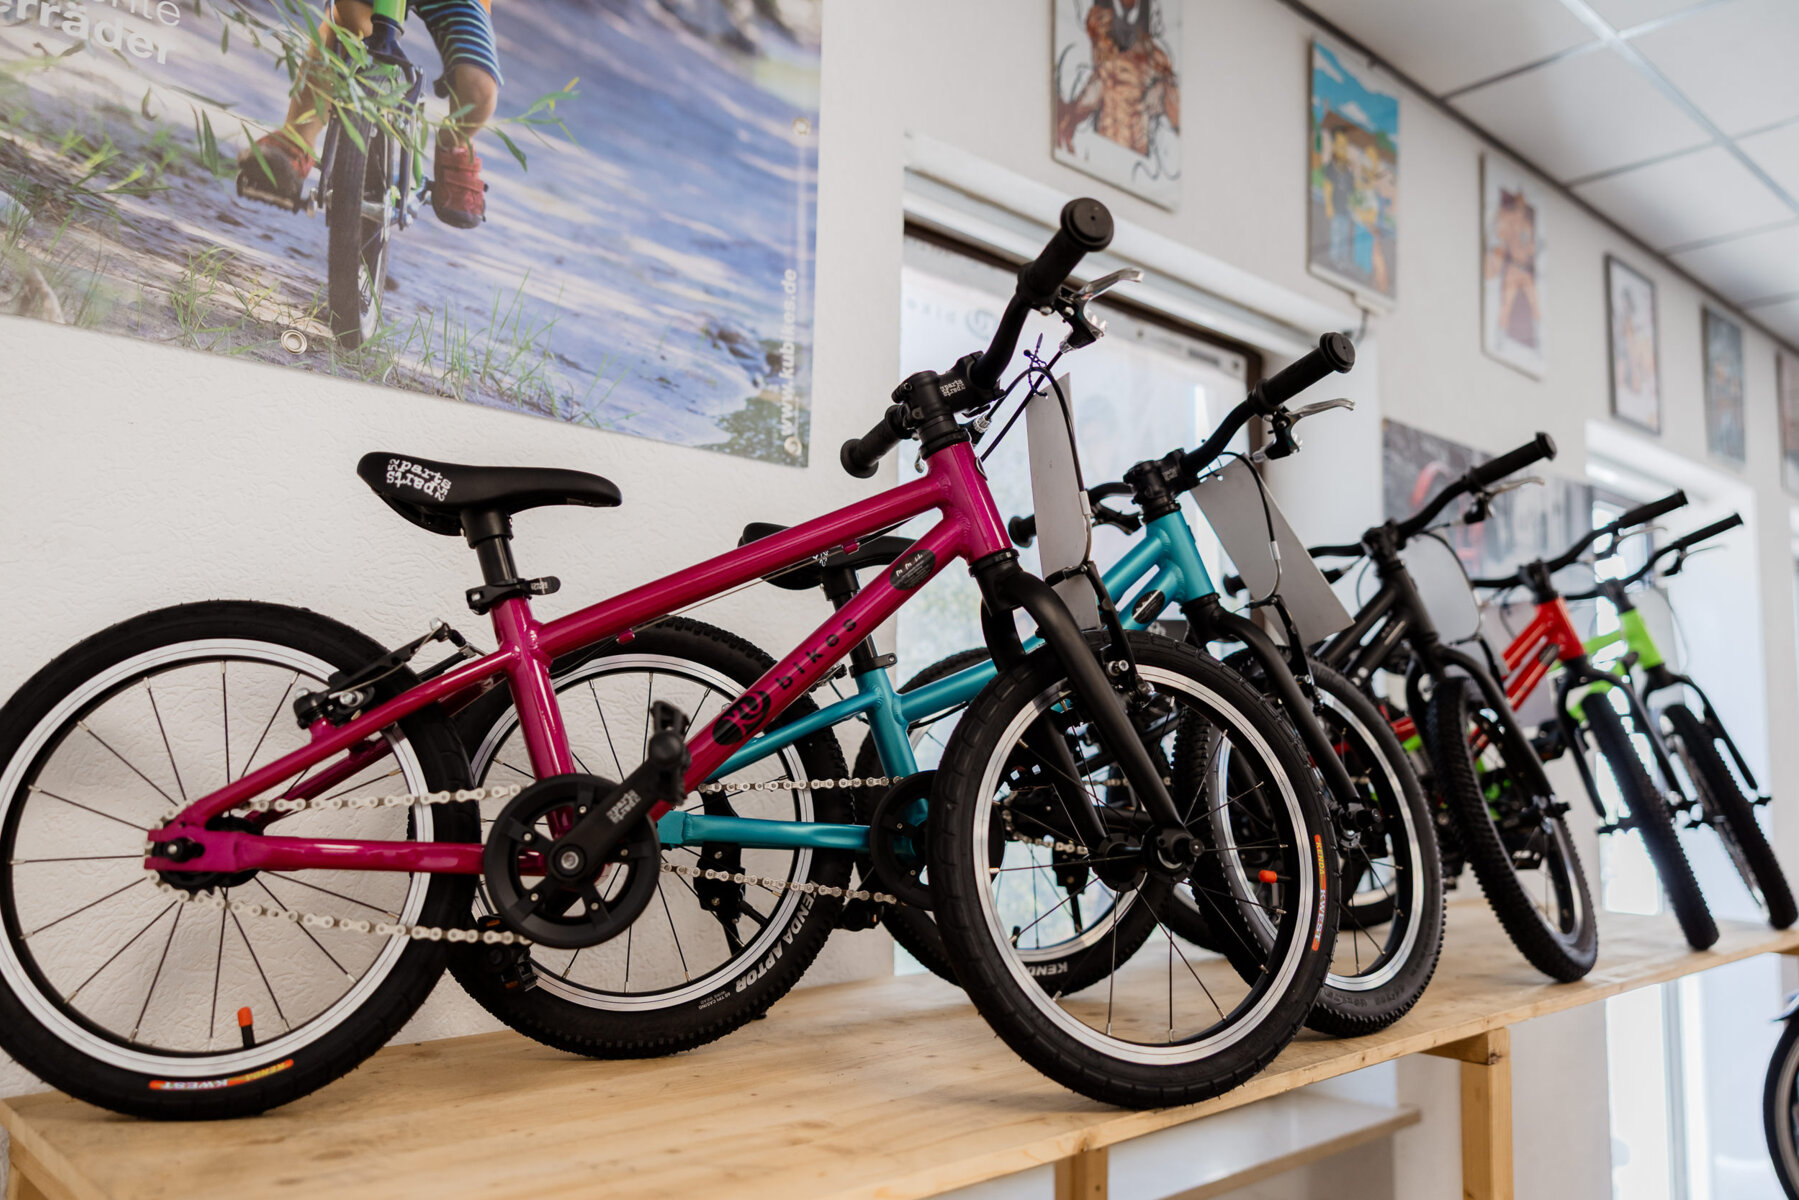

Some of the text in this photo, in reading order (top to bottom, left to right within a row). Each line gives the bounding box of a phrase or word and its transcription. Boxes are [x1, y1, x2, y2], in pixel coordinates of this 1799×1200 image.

[0, 0, 170, 64] rräder
[780, 268, 798, 436] www.kubikes.de
[386, 471, 438, 496] parts
[398, 460, 452, 490] parts
[775, 618, 857, 690] bikes
[1314, 840, 1327, 943] KENDA KWEST
[735, 945, 783, 993] APTOR
[1027, 961, 1068, 977] KEND
[161, 1078, 229, 1090] KWEST
